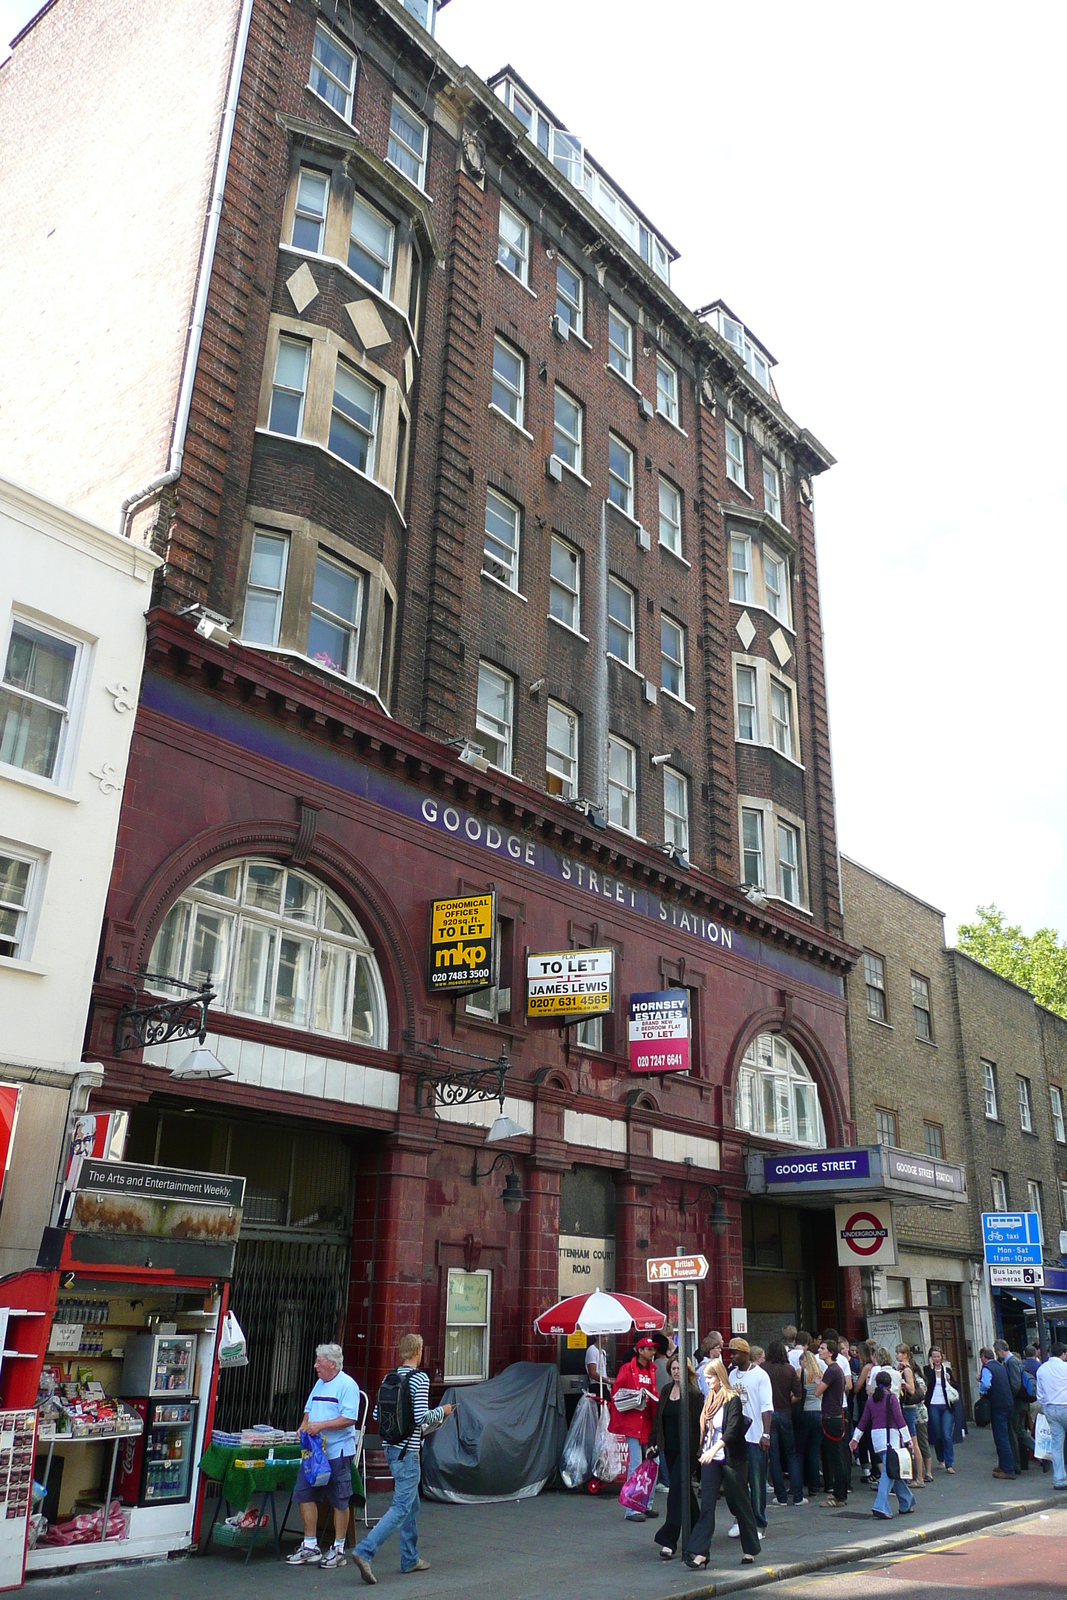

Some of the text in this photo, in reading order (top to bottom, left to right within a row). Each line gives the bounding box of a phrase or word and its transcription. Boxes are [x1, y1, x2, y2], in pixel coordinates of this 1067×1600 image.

[421, 798, 733, 949] GOODGE STREET STATION
[436, 899, 489, 911] ECONOMICAL
[445, 908, 479, 918] OFFICES
[438, 924, 485, 938] TO LET
[435, 942, 487, 969] mkp
[540, 959, 598, 974] TO LET
[432, 968, 489, 982] 020 7483 3500
[530, 981, 608, 996] JAMES LEWIS
[530, 995, 608, 1008] 0207 631 4565
[632, 1000, 685, 1012] HORNSEY
[538, 1005, 598, 1013] www.jameslewis.co.uk
[635, 1010, 683, 1021] ESTATES
[637, 1054, 682, 1068] 020 7247 6641
[775, 1160, 857, 1175] GOODGE STREET
[896, 1162, 954, 1183] GOODGE STREET STATION
[89, 1171, 231, 1197] The Arts and Entertainment Weekly.
[842, 1230, 886, 1238] UNDERGROUND
[593, 1250, 614, 1260] COURT
[572, 1265, 591, 1274] ROAD
[675, 1260, 695, 1268] British
[550, 1326, 564, 1334] Sun
[737, 1323, 745, 1332] LFB
